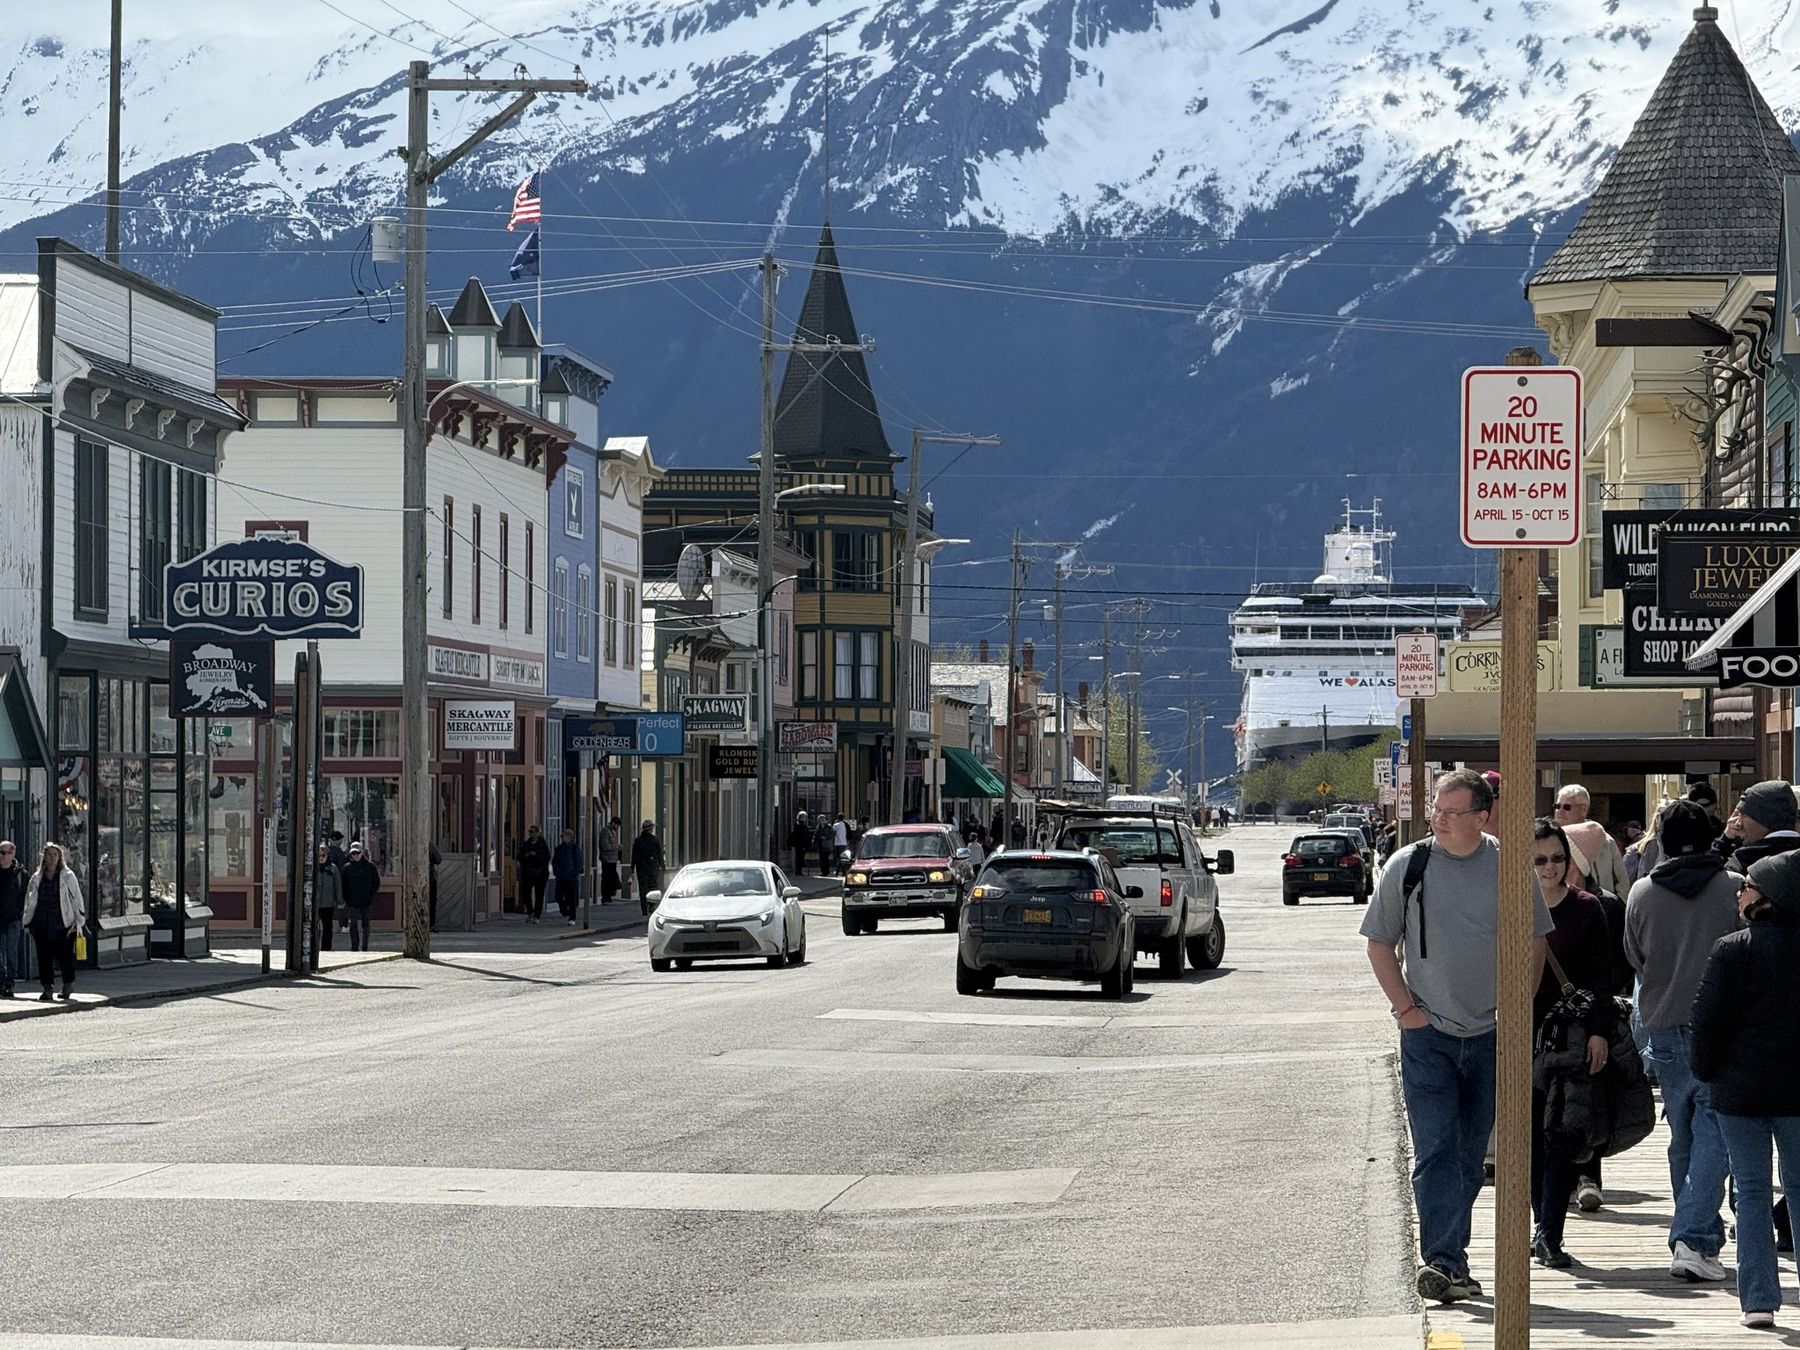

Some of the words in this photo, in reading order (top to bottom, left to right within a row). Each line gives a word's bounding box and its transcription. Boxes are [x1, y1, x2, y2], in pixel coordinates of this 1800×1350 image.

[1508, 396, 1537, 418] 20
[1481, 423, 1563, 444] MINUTE
[1473, 449, 1571, 470] PARKING
[1478, 483, 1566, 499] 8AM-6PM
[1474, 510, 1507, 520] APRIL
[1558, 510, 1569, 520] 15
[1613, 523, 1658, 555] WILD
[202, 559, 326, 577] KIRMSE'S
[173, 581, 353, 618] CURIOS
[1411, 644, 1422, 653] 20
[1600, 648, 1609, 664] A
[1643, 640, 1679, 663] SHOP
[183, 658, 257, 674] BROADWAY
[1402, 654, 1431, 662] MINUTE
[1399, 663, 1434, 671] PARKING
[1721, 655, 1800, 680] FOO
[1319, 678, 1343, 687] WE
[1359, 678, 1396, 687] ALAS
[449, 710, 511, 718] SKAGWAY
[684, 699, 745, 717] SKAGWAY
[211, 726, 225, 736] AVE
[447, 722, 513, 732] MERCANTILE
[638, 717, 680, 729] Perfect
[784, 724, 834, 746] HARDWARE
[715, 758, 740, 766] GOLD
[742, 758, 757, 766] RUS
[1030, 895, 1046, 903] Jeep
